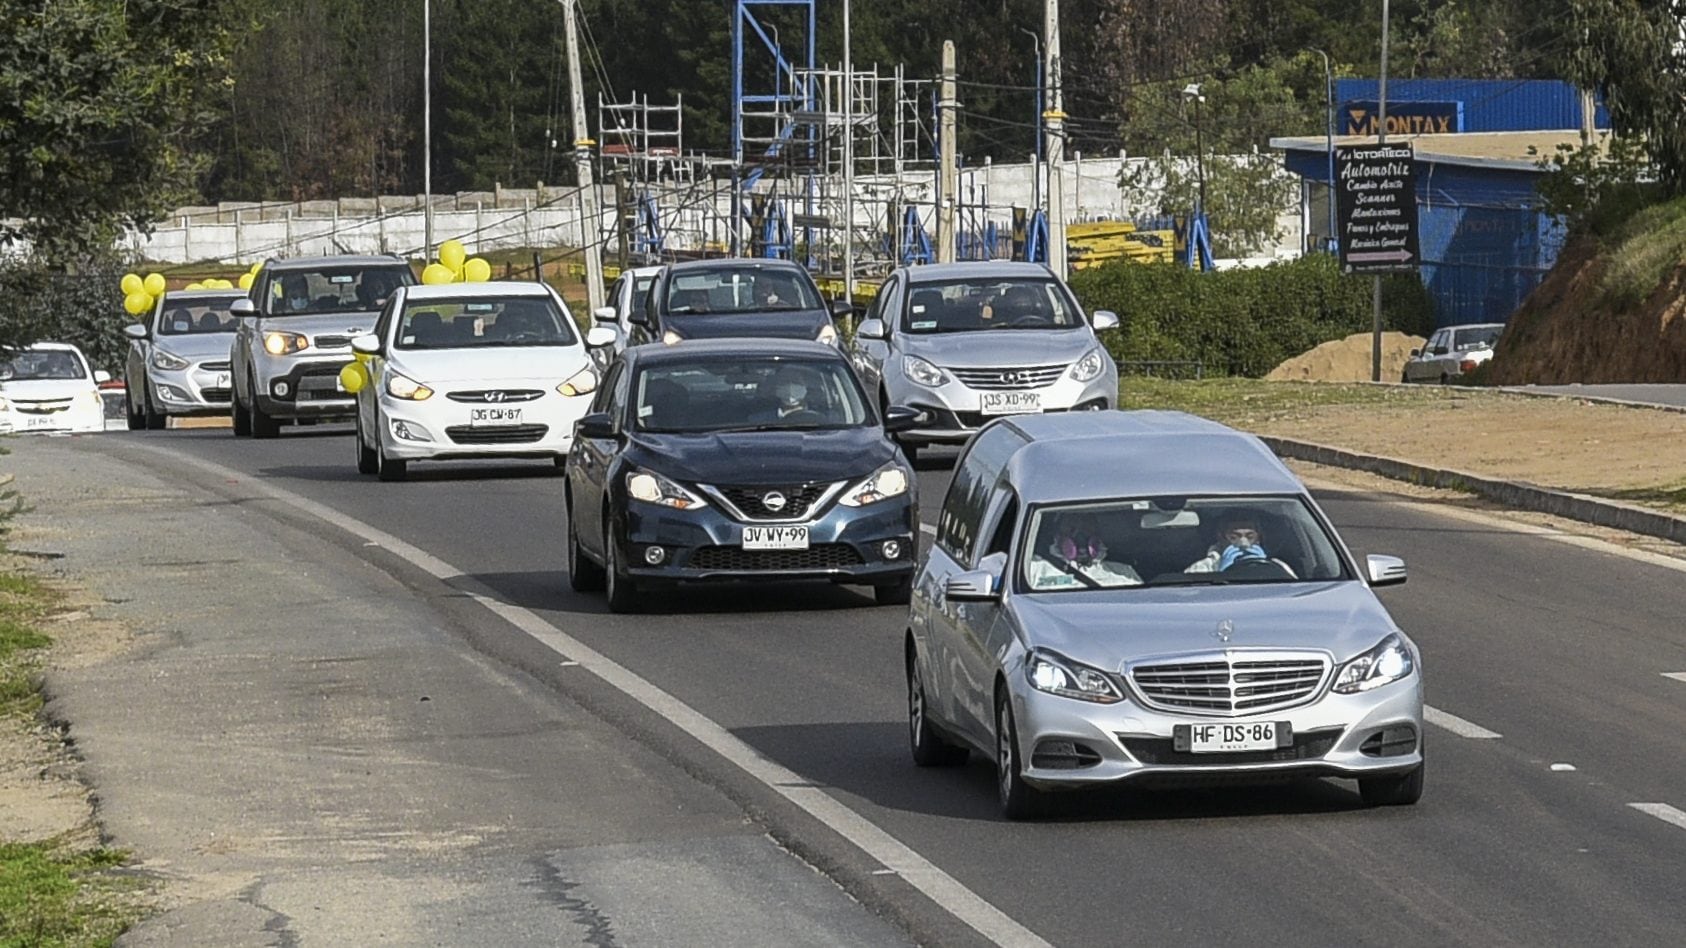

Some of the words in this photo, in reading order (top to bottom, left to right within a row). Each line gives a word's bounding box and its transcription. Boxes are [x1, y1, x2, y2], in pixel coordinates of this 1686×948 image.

[1370, 115, 1451, 135] MONTAX
[1341, 161, 1409, 180] Automotriz
[1355, 192, 1396, 205] Scanner
